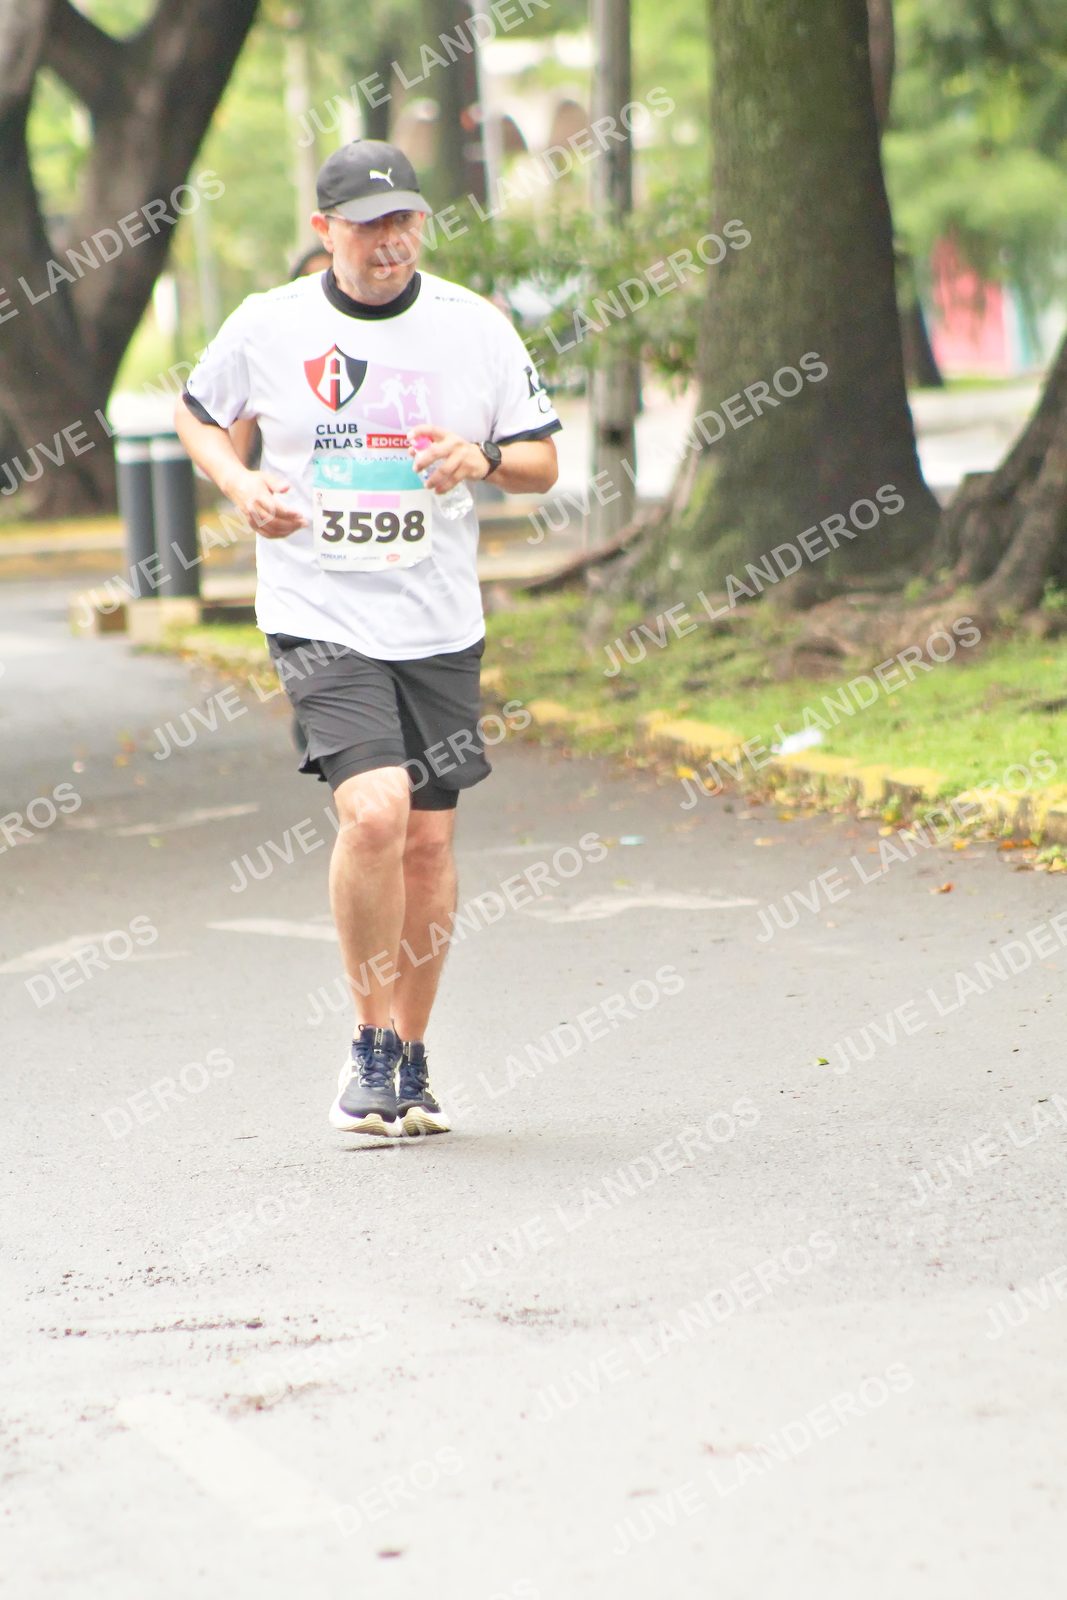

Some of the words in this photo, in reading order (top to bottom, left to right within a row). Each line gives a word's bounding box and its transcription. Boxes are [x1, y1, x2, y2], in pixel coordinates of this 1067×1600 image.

[316, 424, 358, 435] CLUB
[313, 438, 363, 450] ATLAS
[321, 510, 425, 544] 3598
